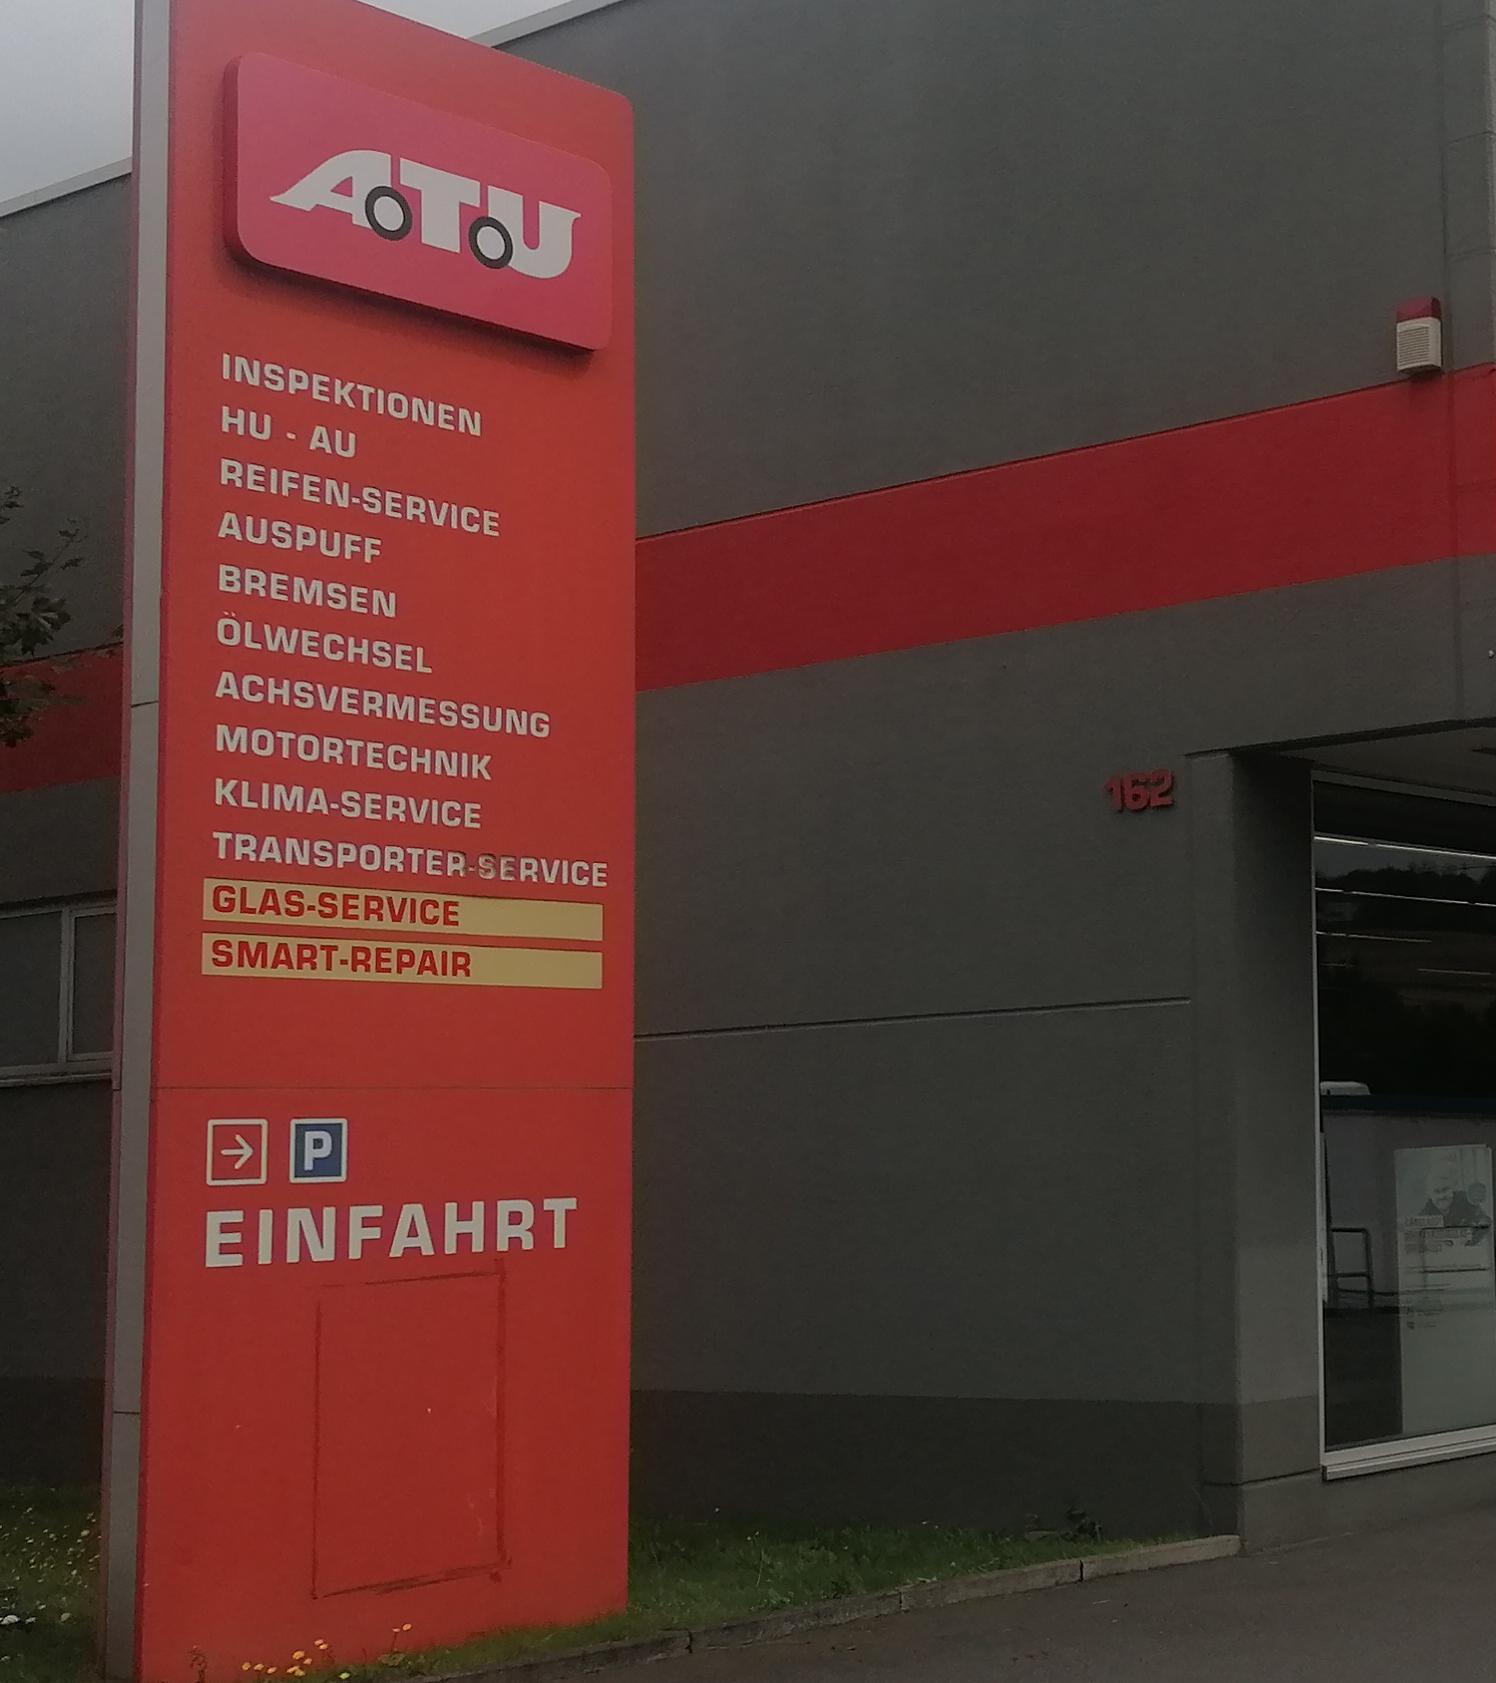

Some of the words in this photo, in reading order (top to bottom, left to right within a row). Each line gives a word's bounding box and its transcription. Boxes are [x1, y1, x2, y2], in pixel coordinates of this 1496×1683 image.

[270, 150, 581, 279] ATU
[222, 354, 482, 437] INSPEKTIONEN
[221, 407, 272, 441] HU
[309, 425, 357, 459] AU
[220, 458, 501, 538] REIFEN-SERVICE
[218, 511, 382, 564] AUSPUFF
[219, 564, 397, 618] BREMSEN
[217, 611, 432, 674] ÖLWECHSEL
[215, 671, 550, 739] ACHSVERMESSUNG
[216, 724, 492, 781] MOTORTECHNIK
[214, 778, 481, 830] KLIMA-SERVICE
[1104, 768, 1175, 813] 162
[212, 831, 608, 888] TRANSPORTER-SERVICE
[212, 884, 460, 927] GLAS-SERVICE
[212, 939, 472, 978] SMART-REPAIR
[304, 1130, 333, 1171] P
[205, 1196, 577, 1268] EINFAHRT
